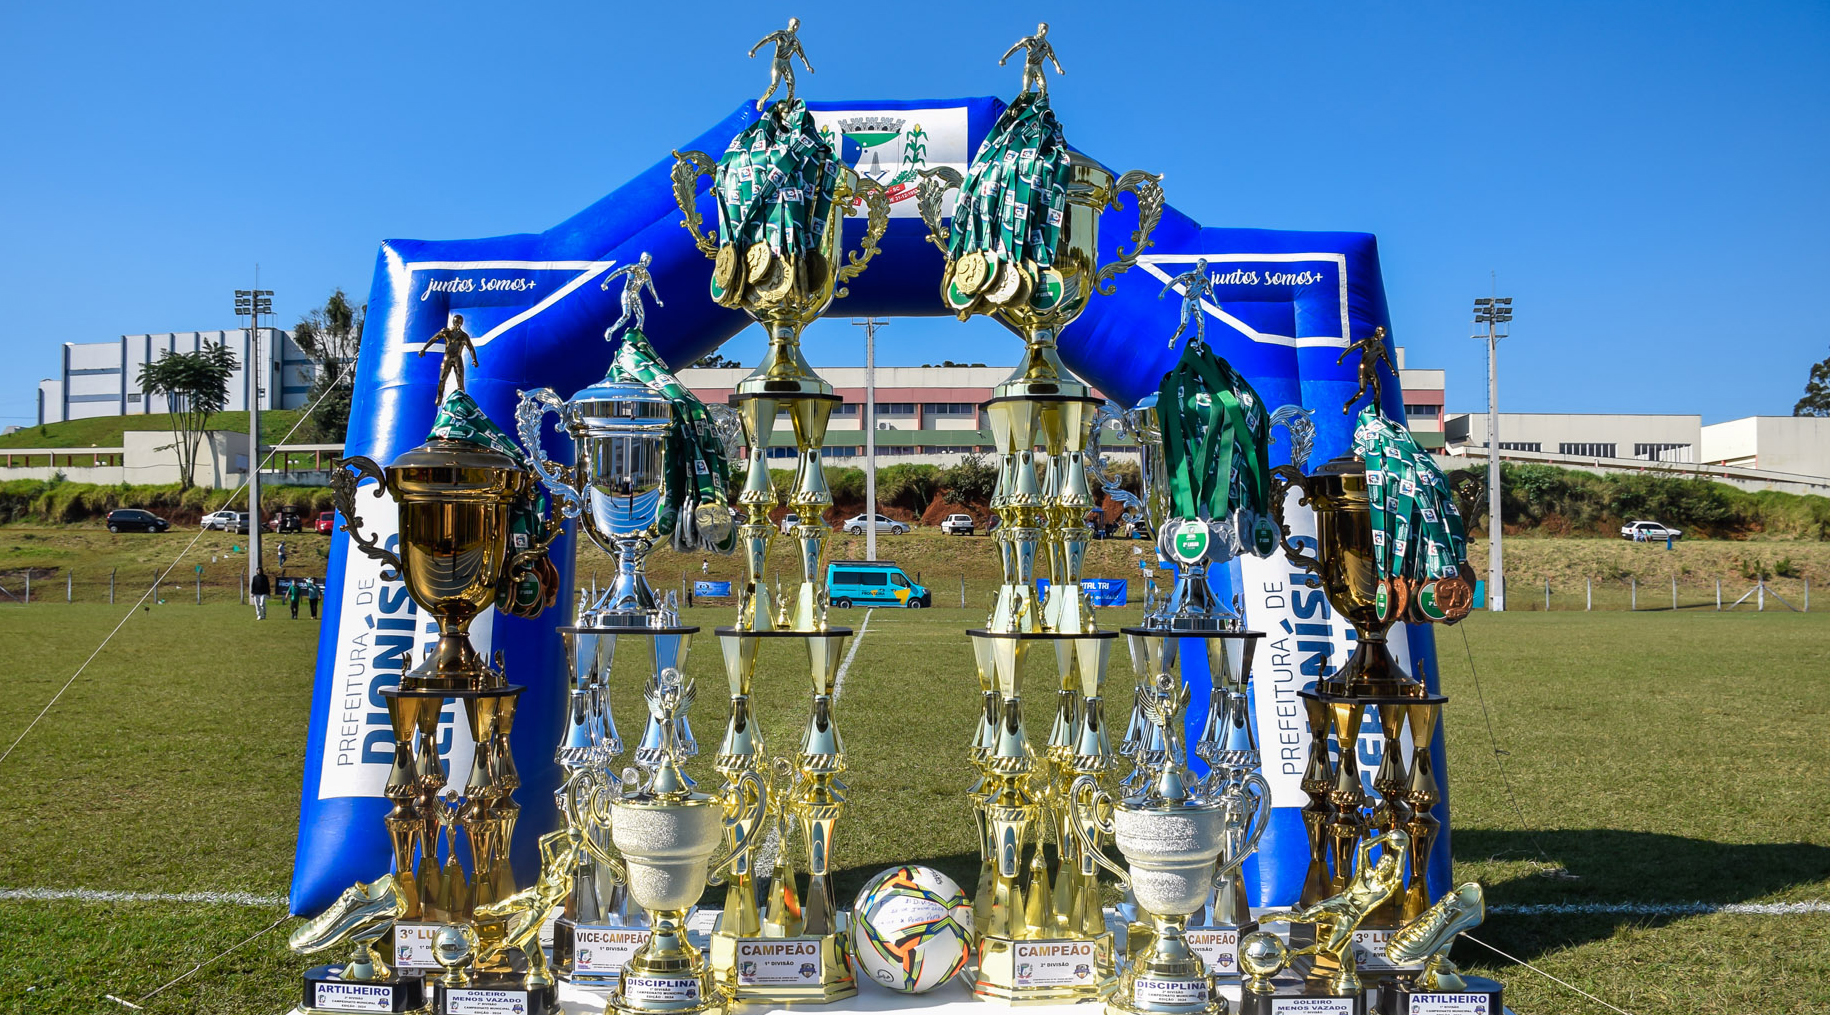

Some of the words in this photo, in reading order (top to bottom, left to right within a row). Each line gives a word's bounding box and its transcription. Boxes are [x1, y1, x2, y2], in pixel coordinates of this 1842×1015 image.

[421, 277, 477, 301] juntos
[1204, 268, 1260, 296] juntos
[1263, 581, 1285, 609] DE
[337, 633, 369, 766] PREFEITURA
[356, 578, 375, 605] DE
[1270, 637, 1303, 775] PREFEITURA
[576, 932, 650, 944] VICE-CAMPEÃO
[741, 942, 816, 956] CAMPEÃO
[1018, 943, 1091, 957] CAMPEÃO
[318, 984, 390, 996] ARTILHEIRO
[627, 978, 696, 988] DISCIPLINA
[1137, 980, 1206, 990] DISCIPLINA
[1411, 995, 1487, 1004] ARTILHEIRO
